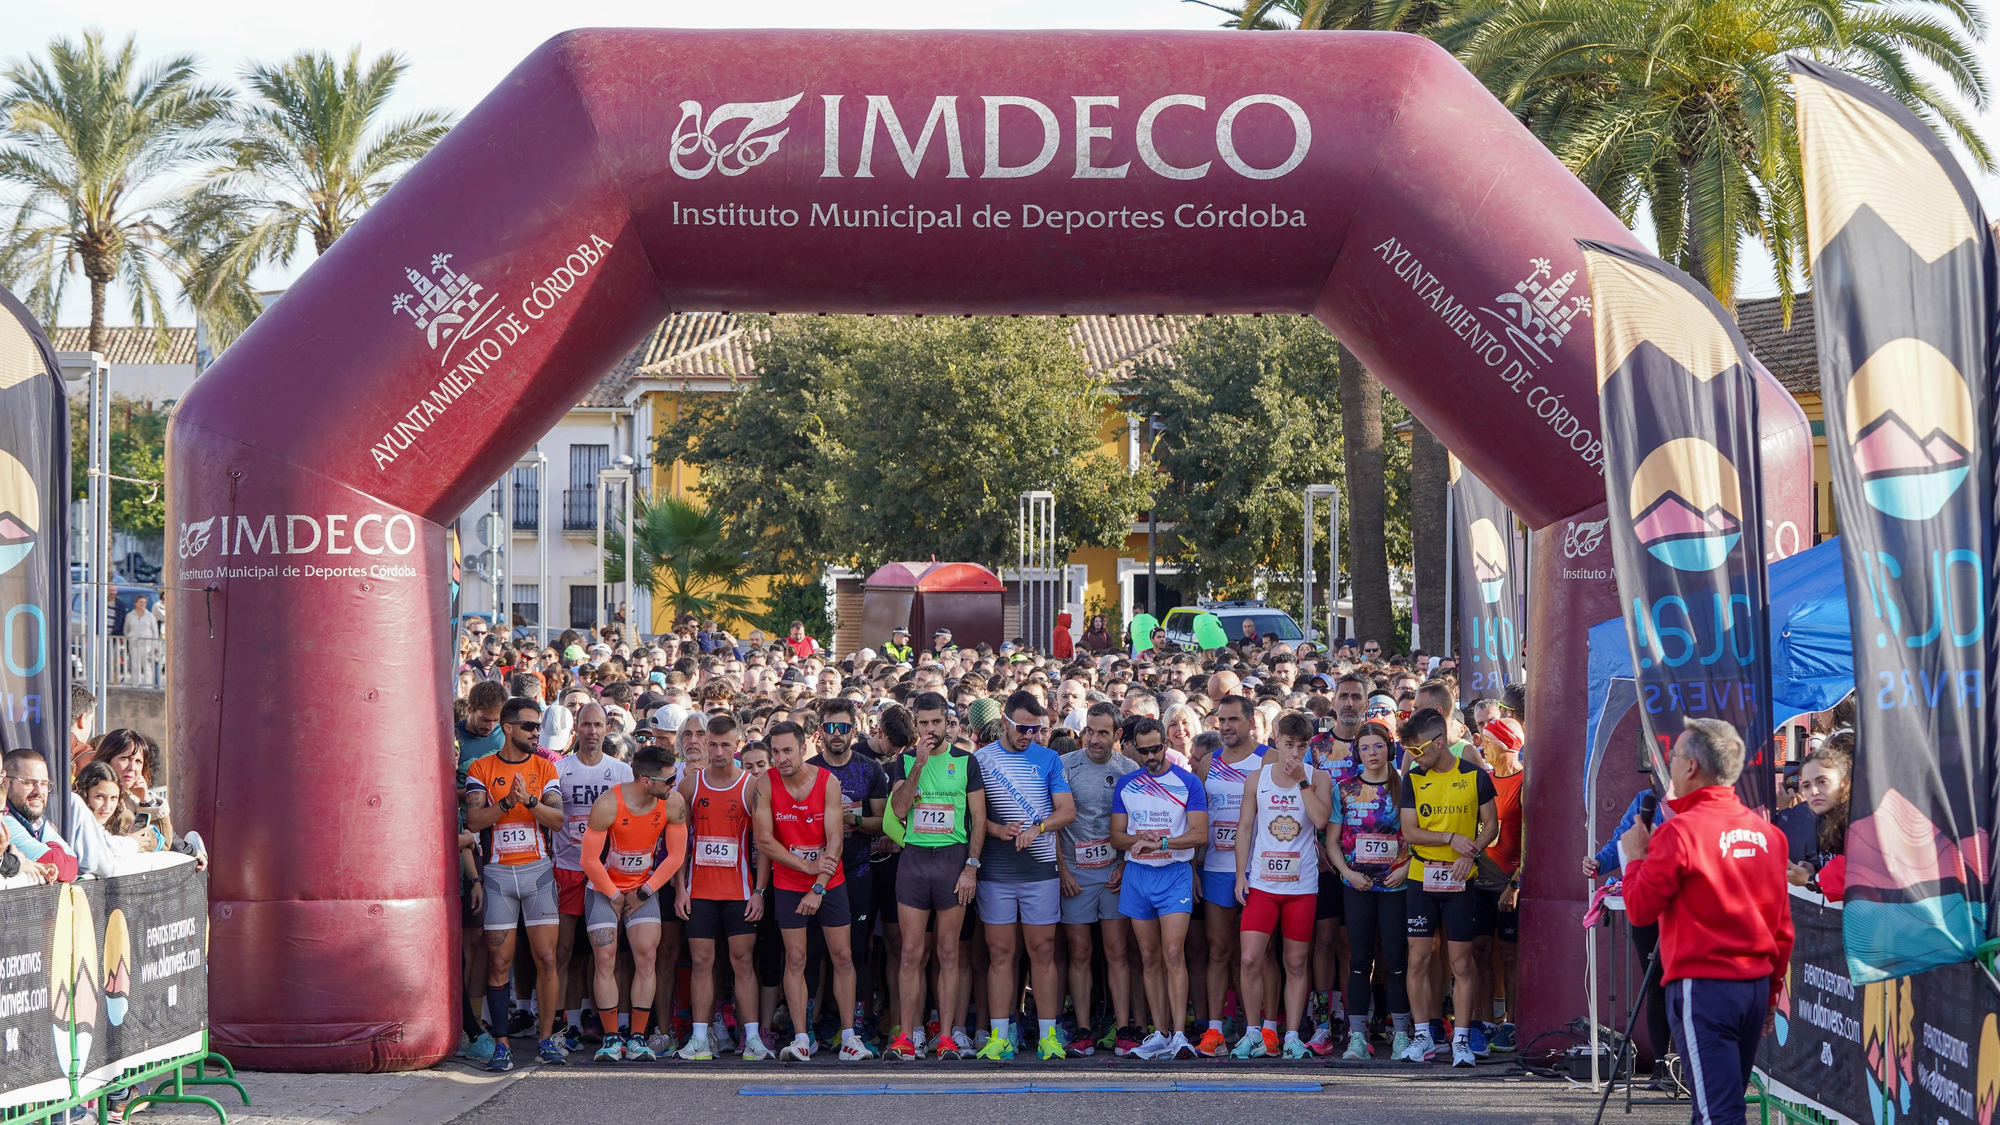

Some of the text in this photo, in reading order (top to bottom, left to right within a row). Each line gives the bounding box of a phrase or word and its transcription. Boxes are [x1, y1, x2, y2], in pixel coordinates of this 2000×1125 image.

[819, 93, 1312, 181] IMDECO
[671, 201, 1307, 234] Instituto Municipal de Deportes Córdoba
[1373, 236, 1507, 366] AYUNTAMIENTO
[1499, 359, 1533, 394] DE
[370, 233, 613, 471] AYUNTAMIENTO DE CÓRDOBA
[220, 514, 416, 555] IMDECO
[179, 564, 416, 581] Instituto Municipal de Deportes Córdoba
[1563, 567, 1607, 580] Instituto
[1271, 794, 1297, 804] CAT
[922, 811, 945, 823] 712
[1419, 803, 1469, 818] AIRZONE
[503, 830, 526, 842] 513
[1217, 829, 1237, 840] 572
[705, 843, 728, 856] 645
[1085, 845, 1108, 859] 515
[1365, 841, 1388, 853] 579
[620, 857, 642, 867] 175
[1268, 859, 1291, 871] 667
[147, 916, 196, 948] EVENTOS DEPORTIVOS
[6, 951, 42, 979] DEPORTIVOS
[141, 945, 200, 984] www.olarivers.com
[1804, 963, 1825, 990] EVENTOS
